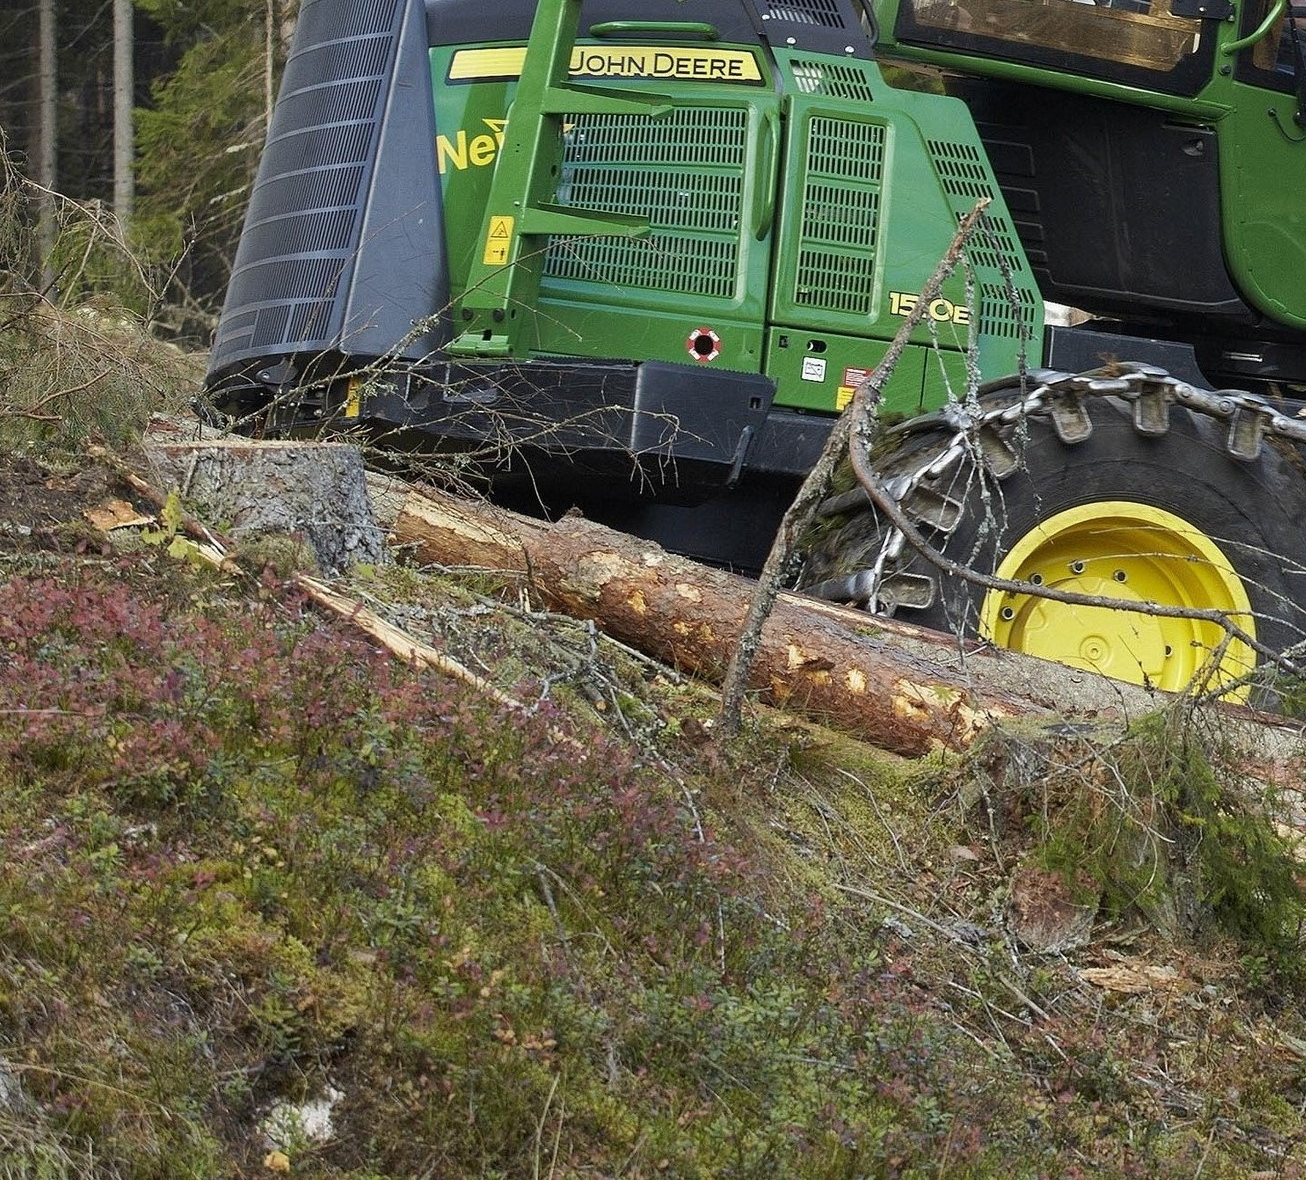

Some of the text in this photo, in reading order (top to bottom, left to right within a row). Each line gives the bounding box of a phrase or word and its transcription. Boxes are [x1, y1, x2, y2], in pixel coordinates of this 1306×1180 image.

[568, 51, 743, 76] JOHN DEERE
[889, 291, 971, 326] 150E
